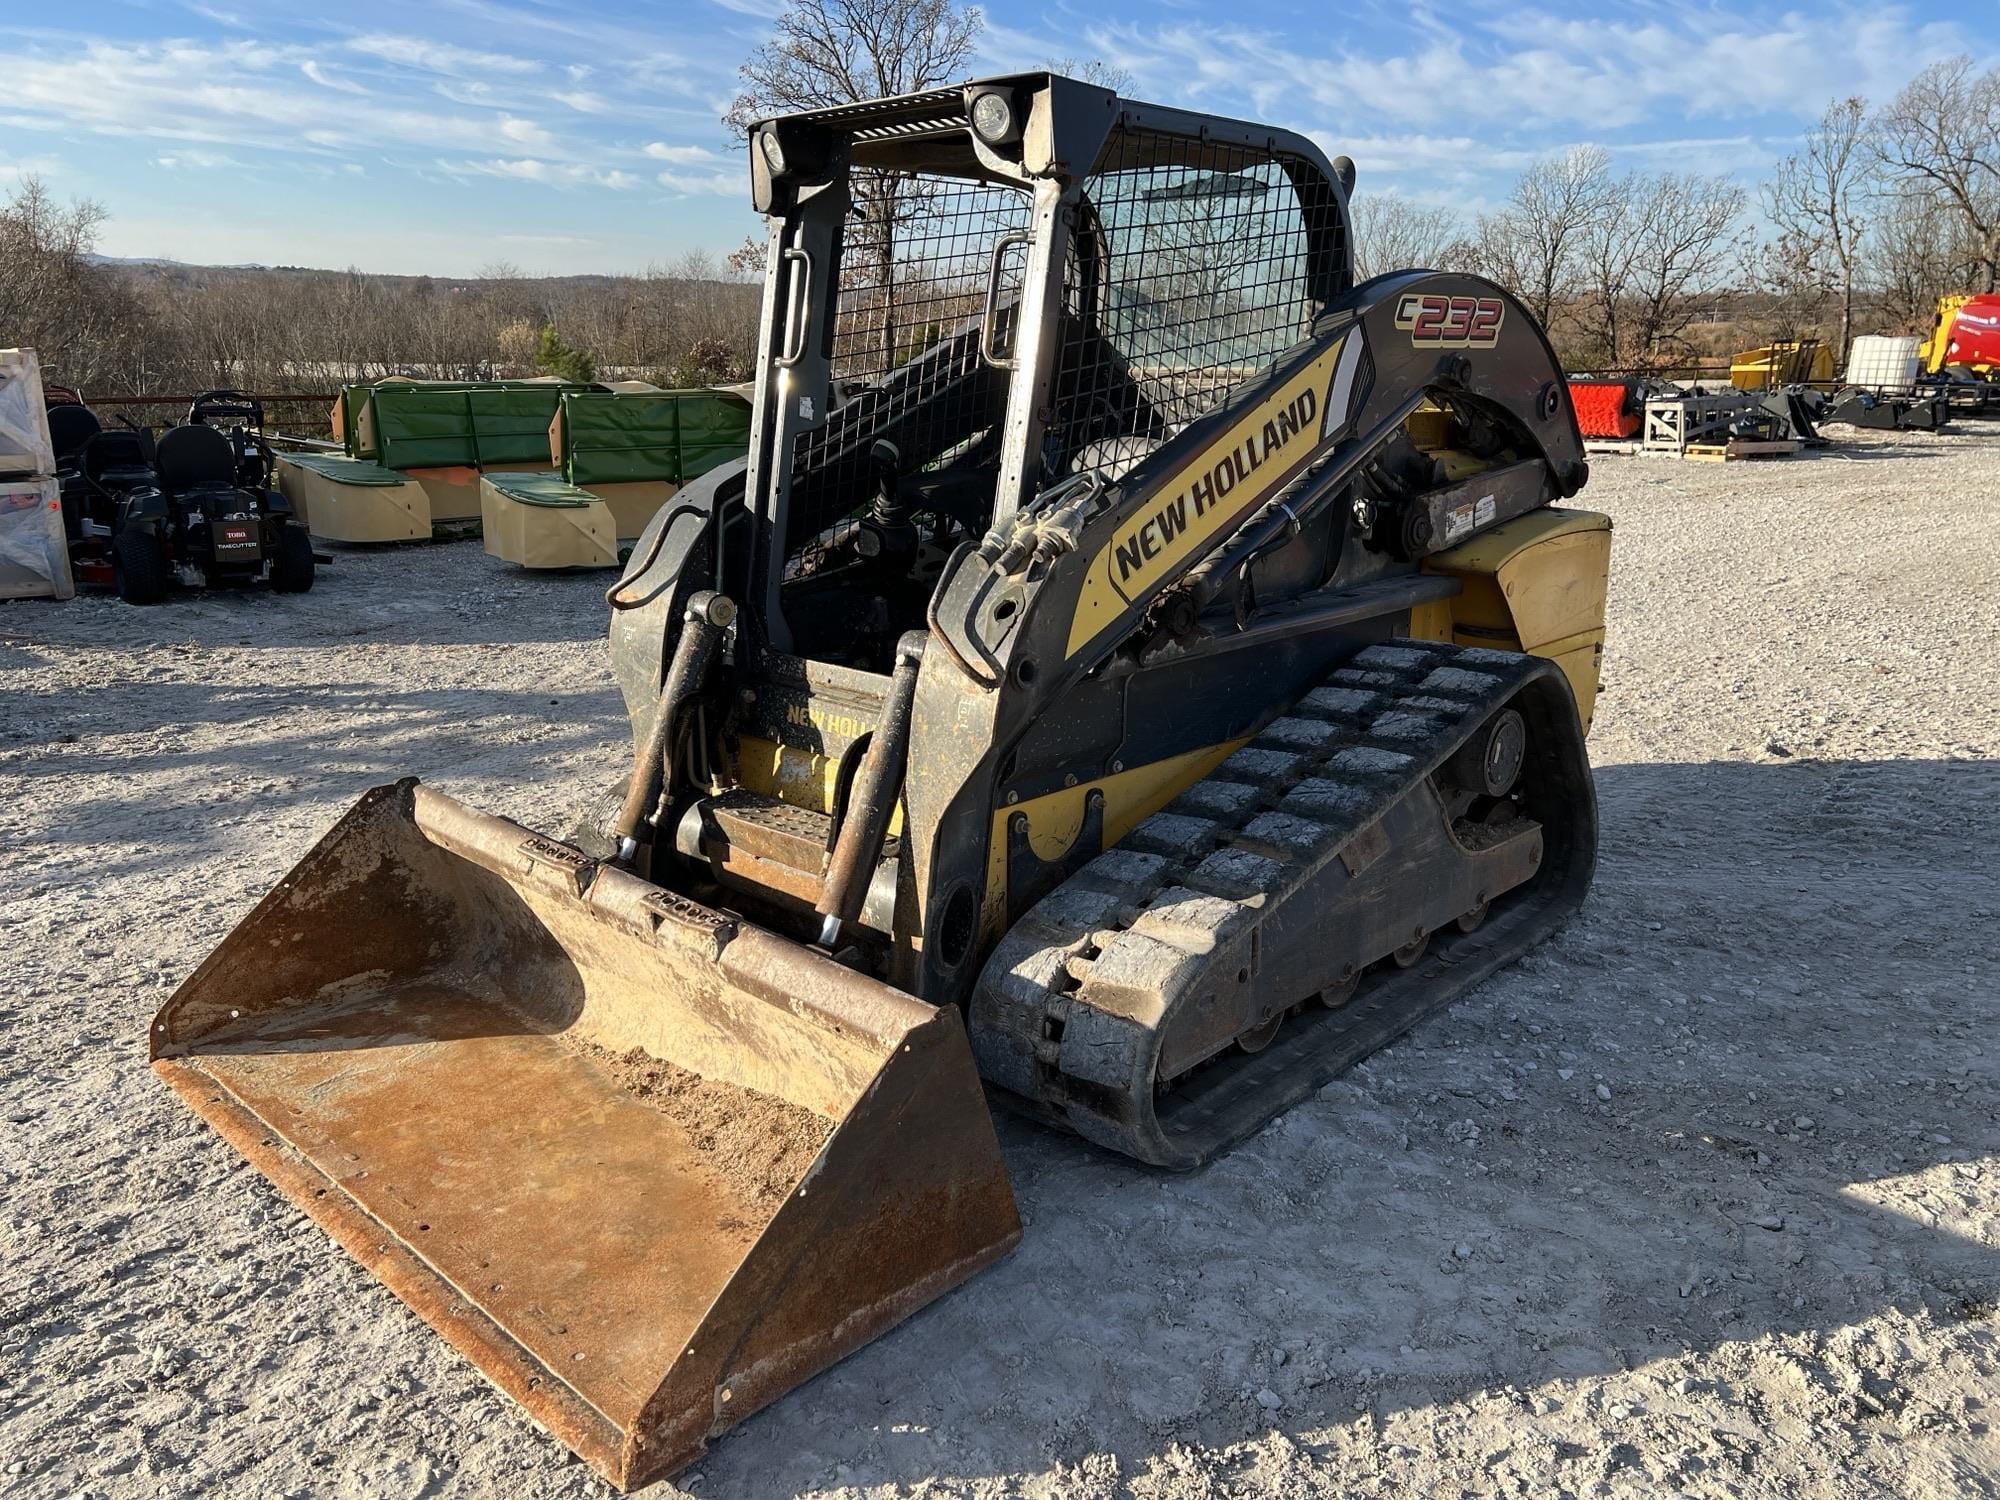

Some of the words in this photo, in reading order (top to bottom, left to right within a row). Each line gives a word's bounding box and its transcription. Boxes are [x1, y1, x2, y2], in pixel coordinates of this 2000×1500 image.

[1395, 295, 1504, 344] C232
[1115, 493, 1187, 582] NEW
[1191, 387, 1317, 518] HOLLAND
[787, 704, 825, 730] NEW
[827, 713, 877, 739] HOLL
